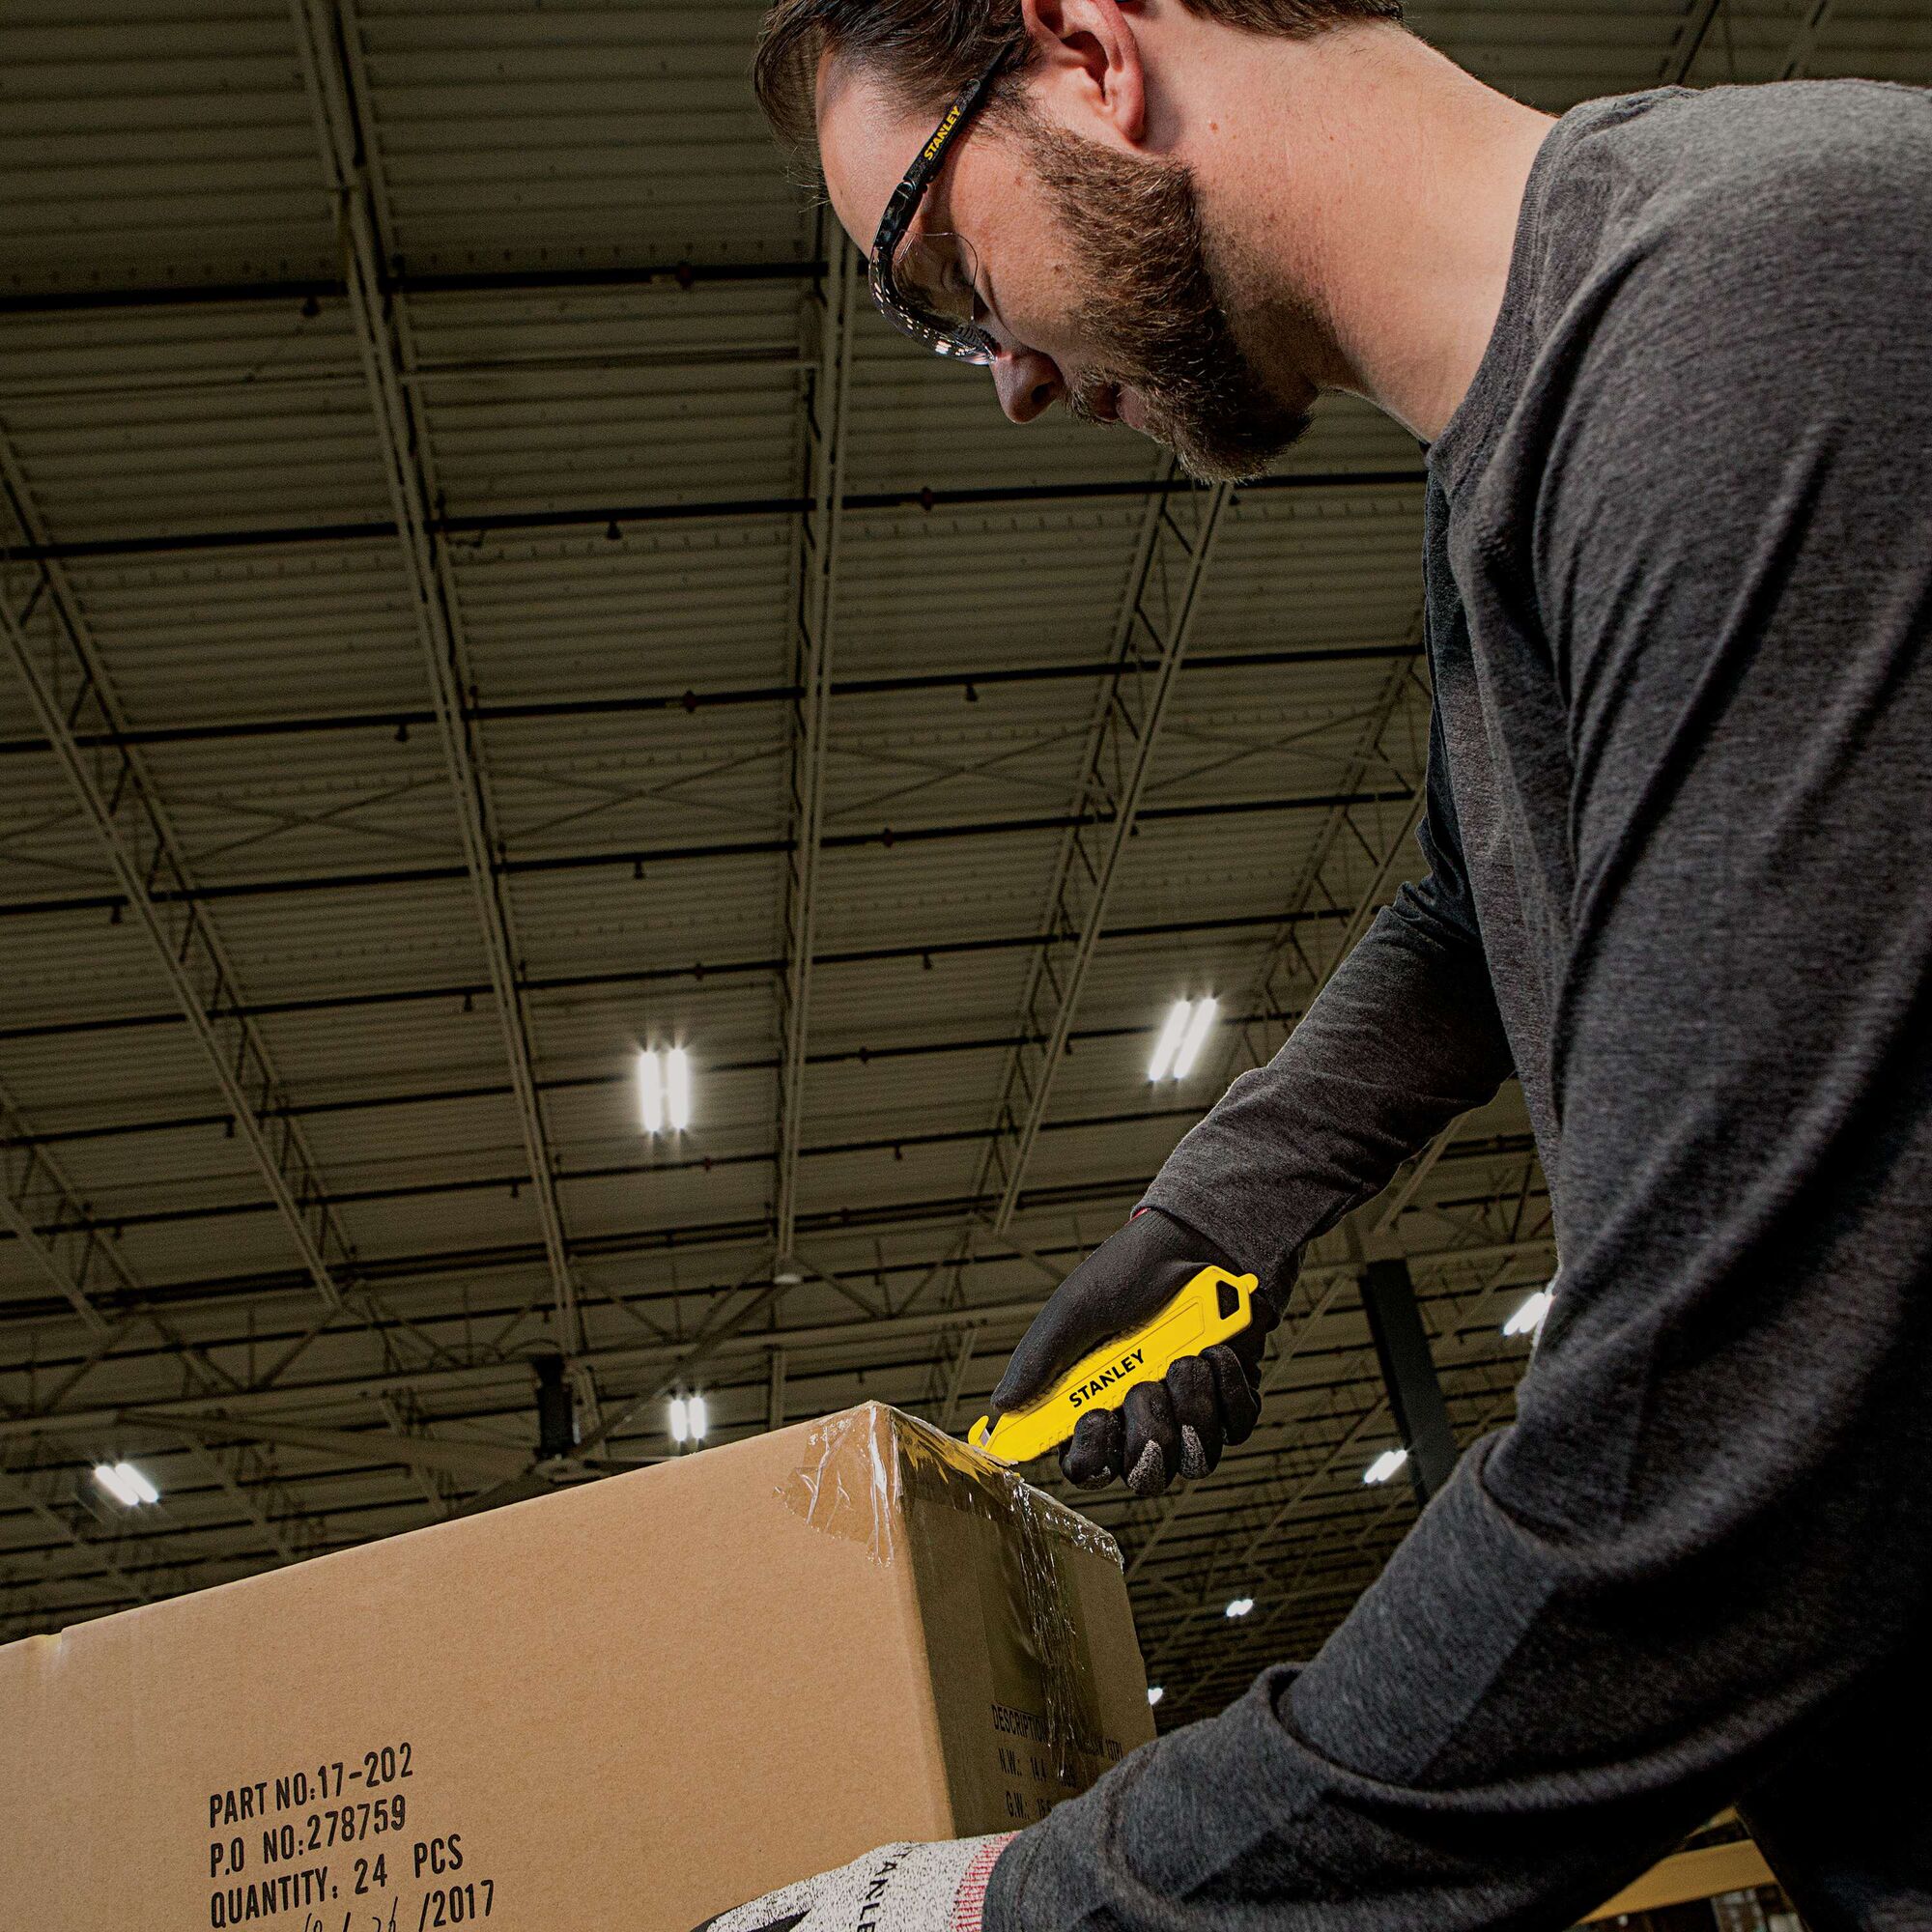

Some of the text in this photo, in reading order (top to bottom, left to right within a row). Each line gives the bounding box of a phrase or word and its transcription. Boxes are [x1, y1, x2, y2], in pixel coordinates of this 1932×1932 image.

[923, 105, 961, 160] STANLEY
[1068, 1349, 1146, 1408] STANLEY
[210, 1782, 269, 1829] PART
[210, 1836, 244, 1878] P.O
[211, 1833, 464, 1929] QUANTITY: 24 PCS
